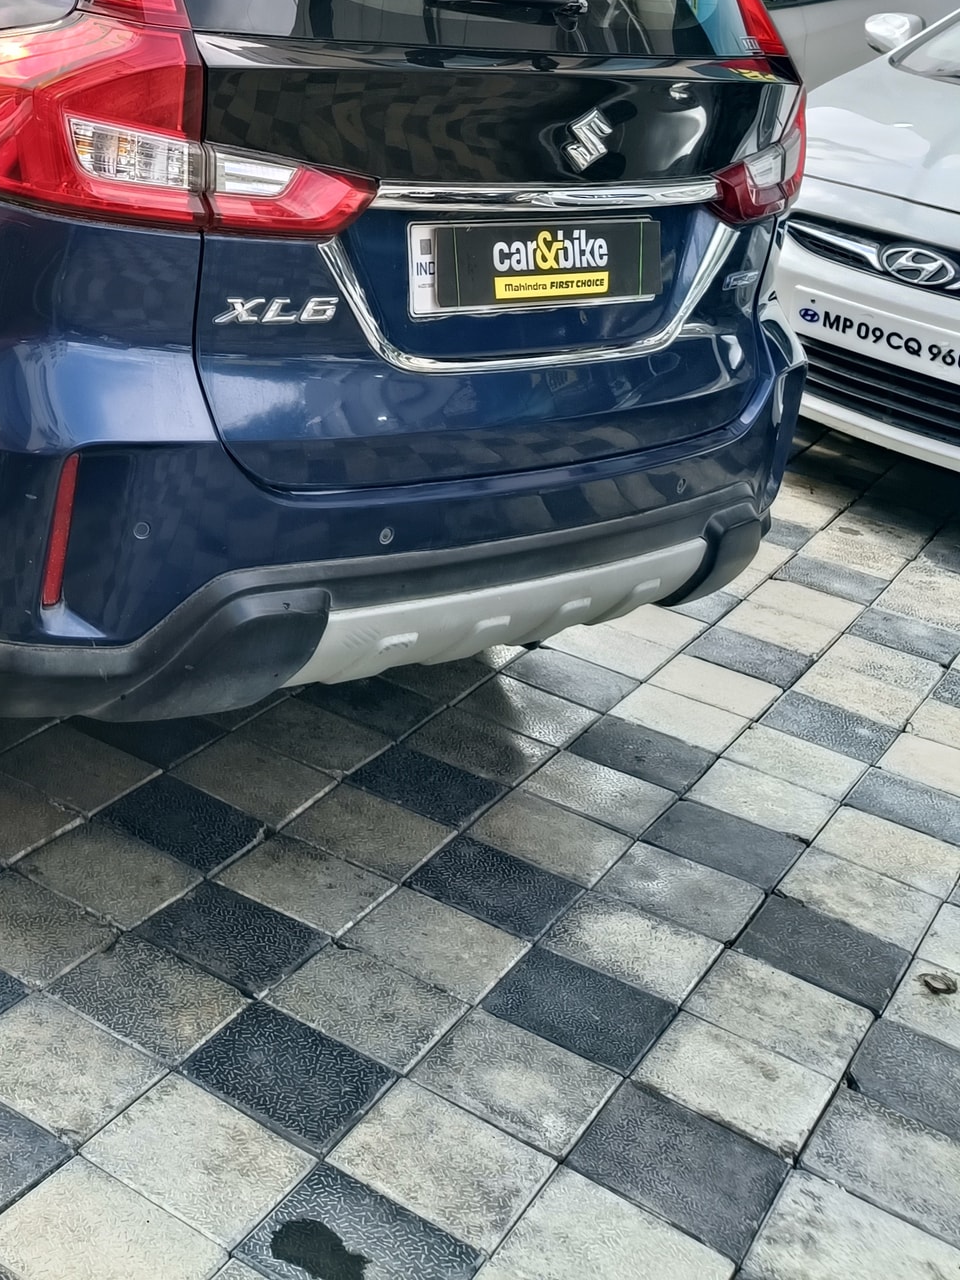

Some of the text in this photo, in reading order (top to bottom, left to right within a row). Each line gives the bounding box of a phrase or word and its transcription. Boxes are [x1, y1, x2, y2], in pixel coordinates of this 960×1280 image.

[493, 229, 609, 272] car&bike
[504, 278, 605, 292] Mahindra FIRST CHOICE
[213, 296, 339, 324] XL6
[928, 344, 960, 369] 96
